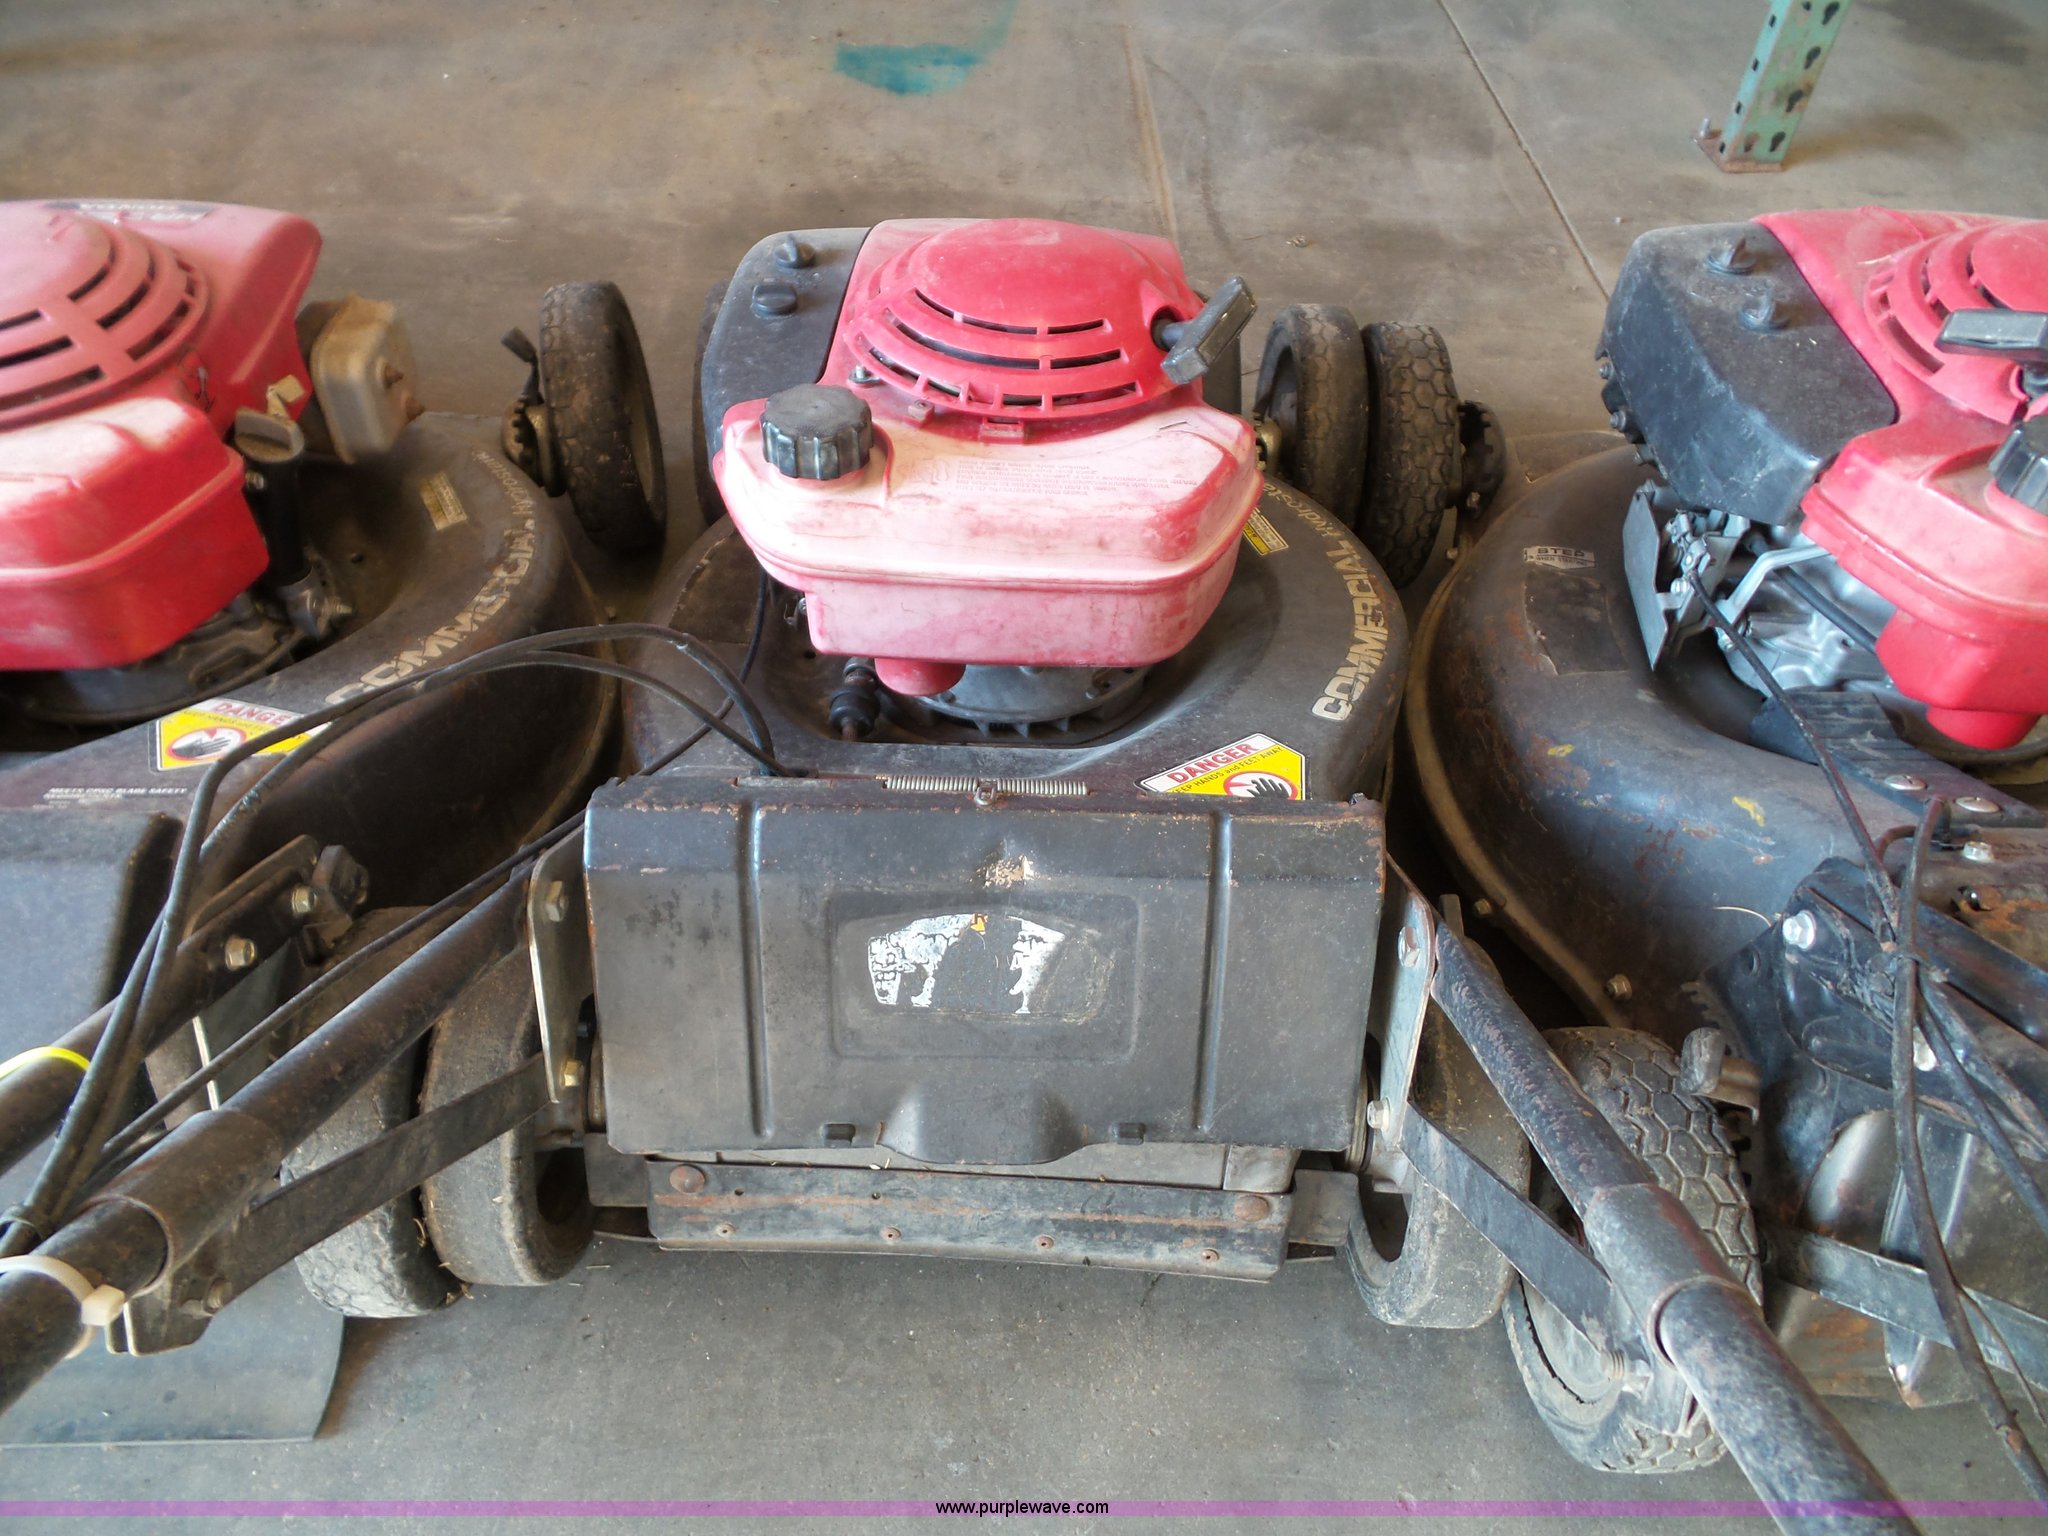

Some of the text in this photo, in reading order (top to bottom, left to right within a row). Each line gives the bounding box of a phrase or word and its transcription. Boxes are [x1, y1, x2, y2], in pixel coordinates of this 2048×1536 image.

[1311, 539, 1390, 722] COMMERCIAL
[209, 701, 292, 725] DANGE
[1166, 743, 1259, 784] DANGER
[1172, 746, 1283, 794] EEP HANDS and FEET AWAY
